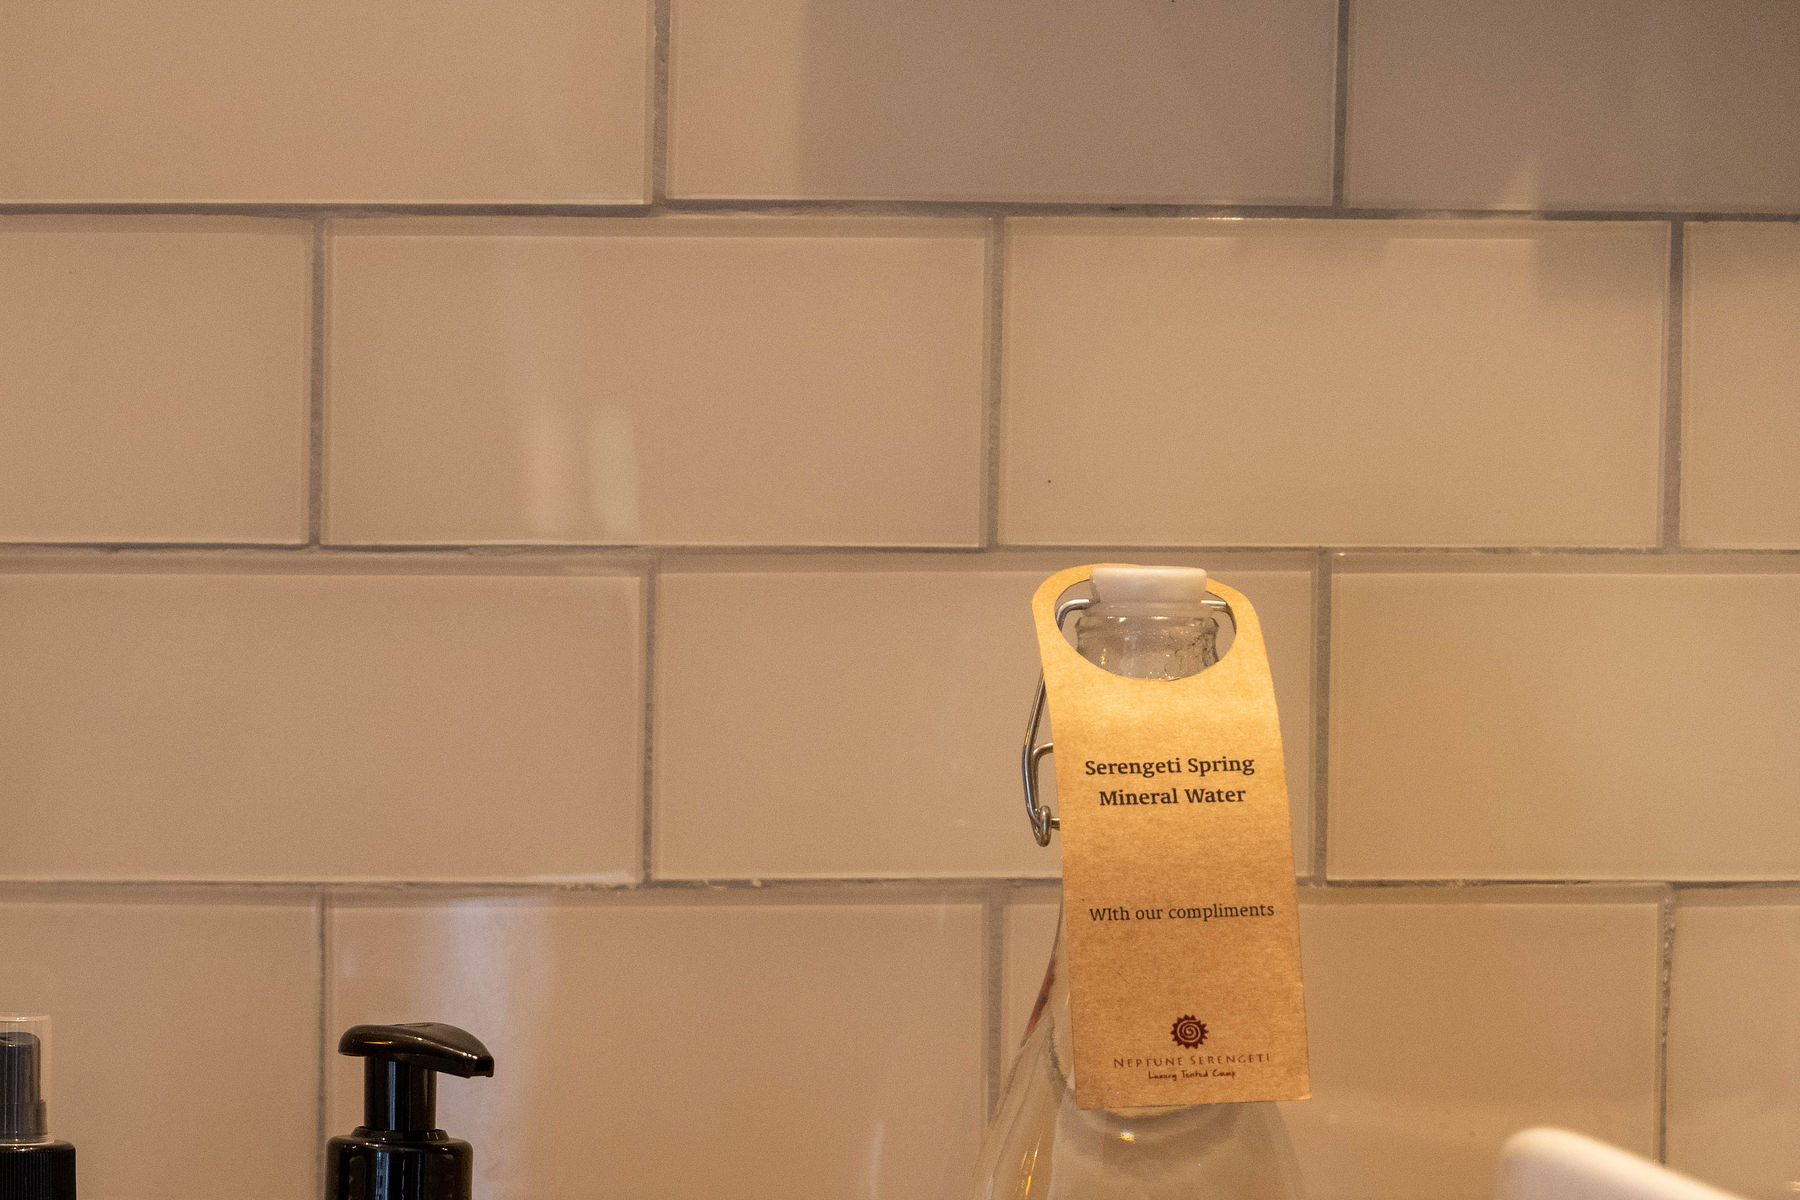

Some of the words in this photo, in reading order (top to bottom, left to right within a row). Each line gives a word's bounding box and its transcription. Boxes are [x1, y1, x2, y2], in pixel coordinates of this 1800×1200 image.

[1085, 758, 1182, 779] Serengeti
[1188, 756, 1255, 776] Spring
[1099, 788, 1178, 806] Mineral
[1185, 787, 1246, 804] Water
[1135, 906, 1163, 920] our
[1168, 903, 1274, 921] compliments
[1114, 1057, 1182, 1068] NEPTUNE
[1190, 1053, 1270, 1066] SERENGETI
[1181, 1070, 1208, 1079] Tented
